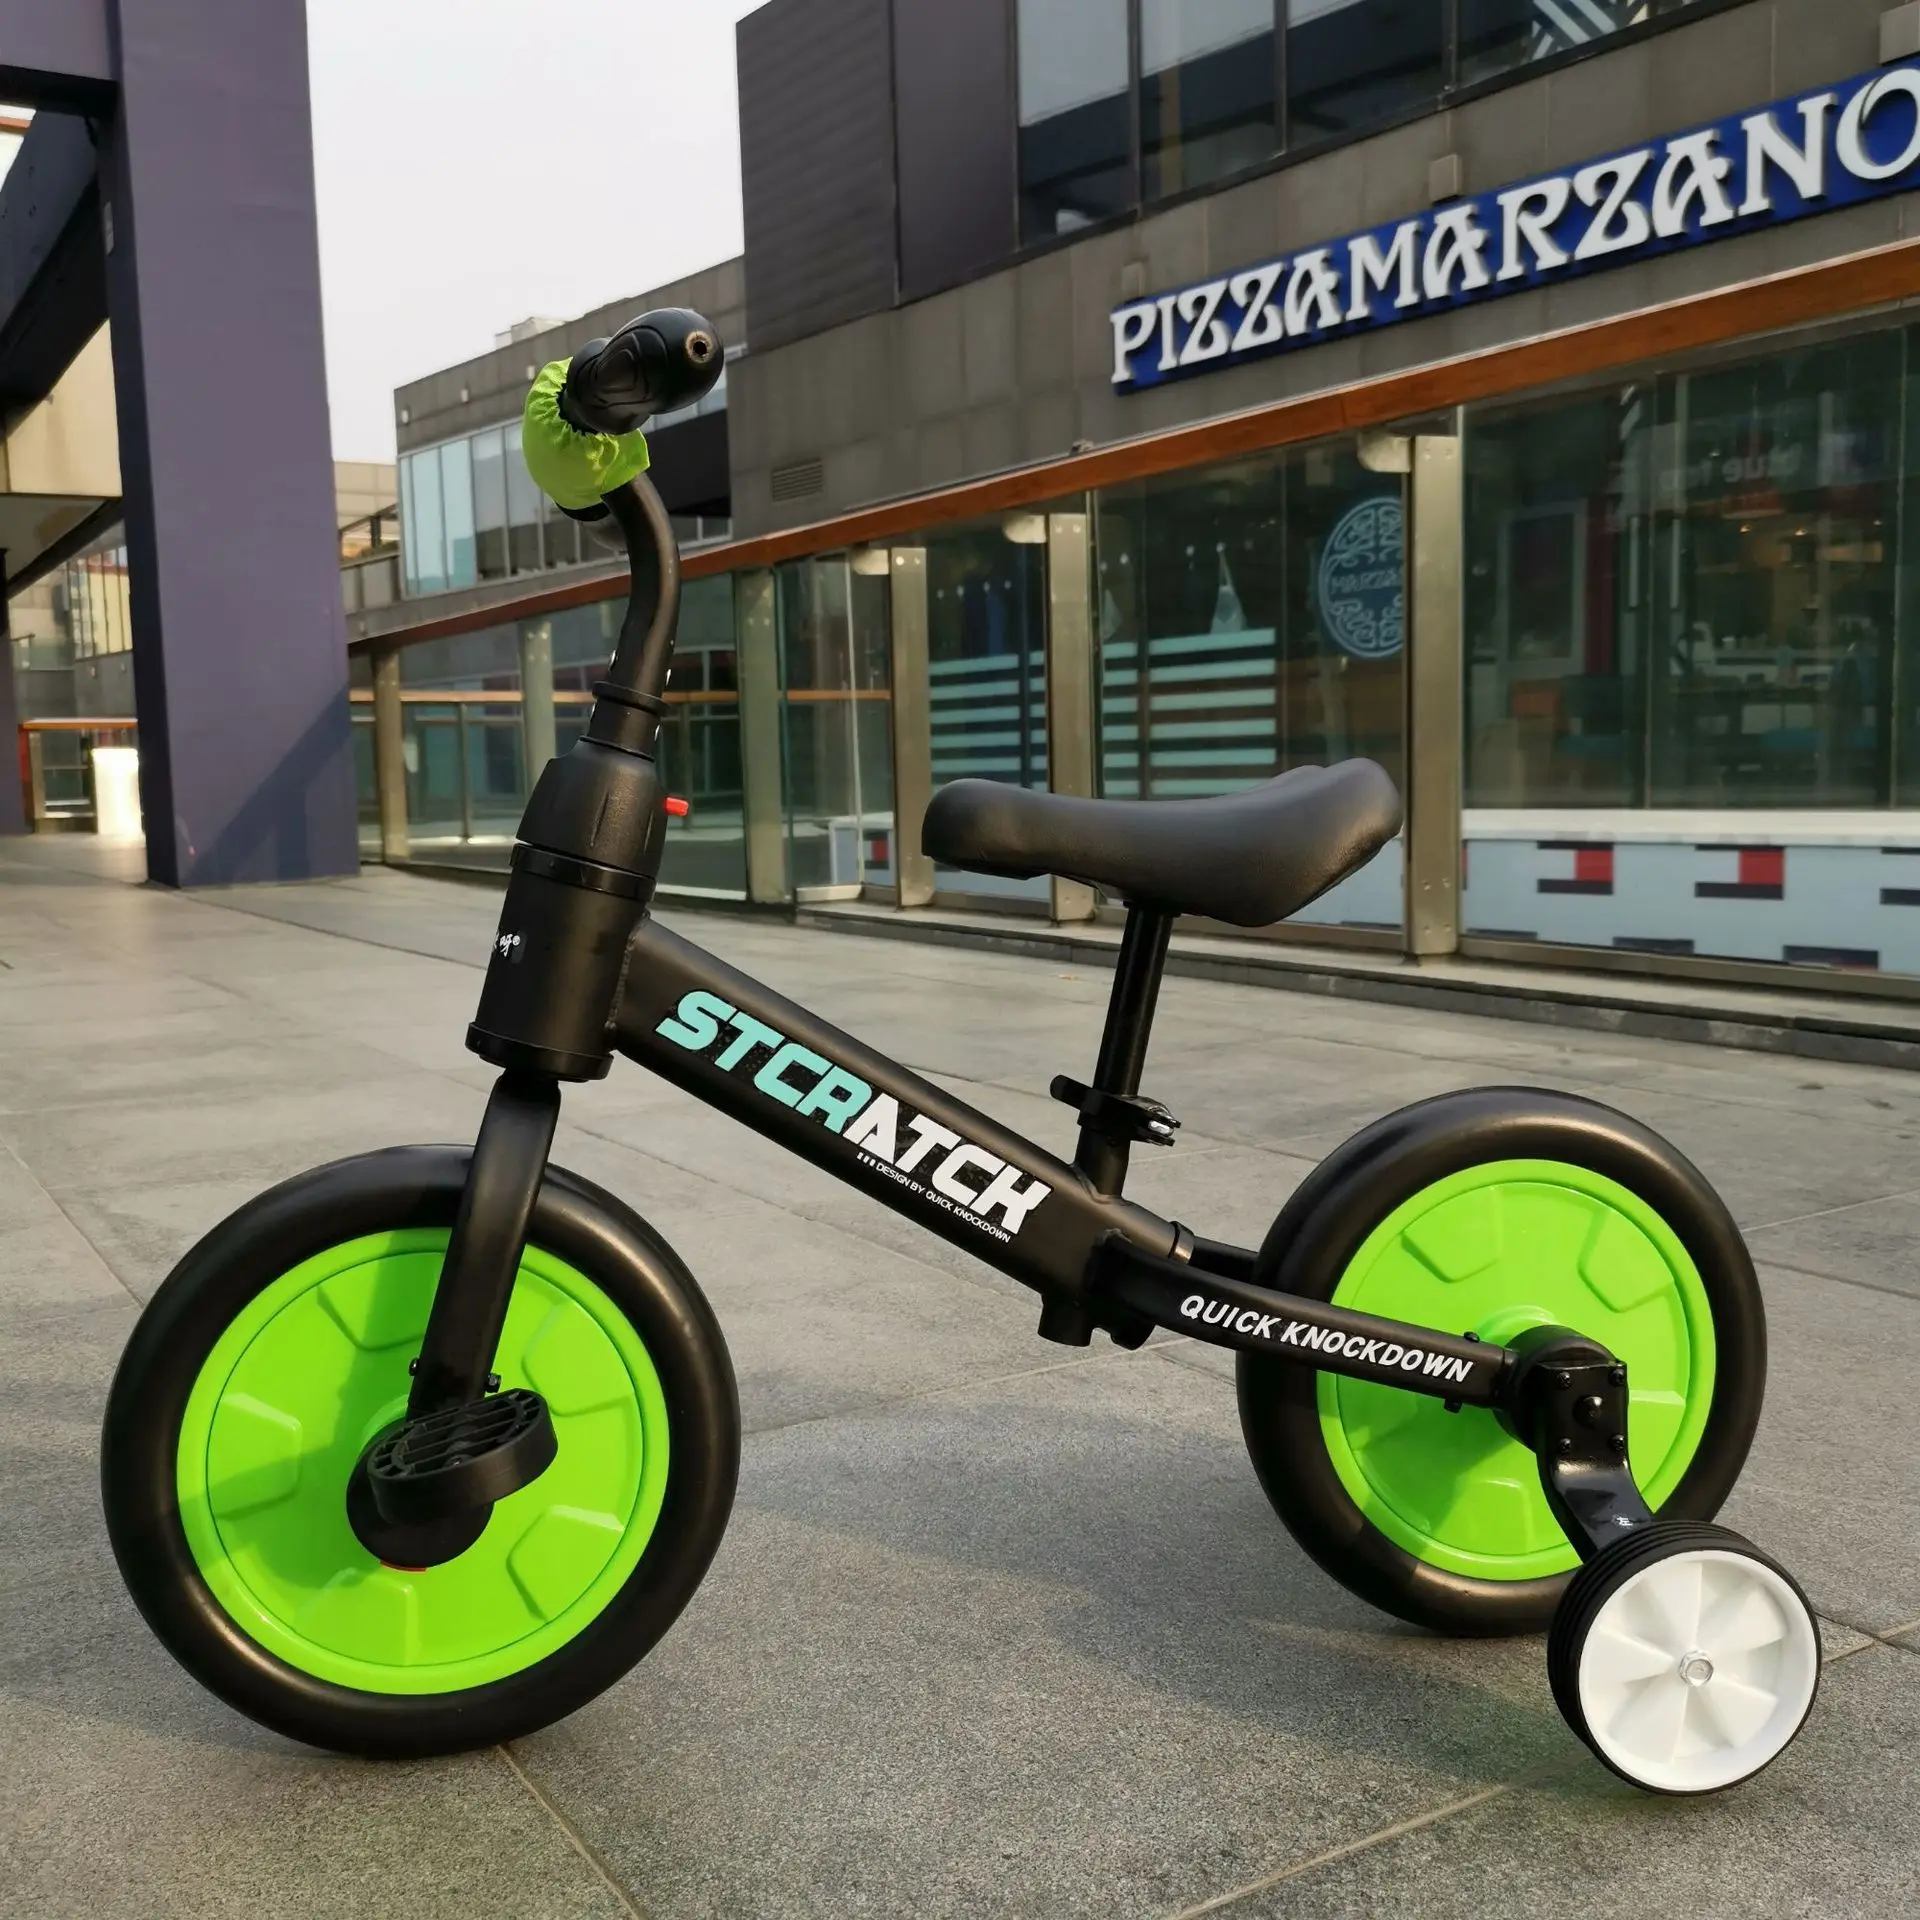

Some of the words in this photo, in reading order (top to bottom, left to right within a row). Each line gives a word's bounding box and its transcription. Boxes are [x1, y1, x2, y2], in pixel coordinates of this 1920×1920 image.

[875, 1162, 911, 1187] DESIGN
[909, 1182, 926, 1194] BY
[925, 1190, 953, 1211] QUICK
[953, 1206, 1011, 1243] KNOCKDOWN
[1179, 1294, 1283, 1339] QUICK
[1280, 1321, 1473, 1382] KNOCKDOWN
